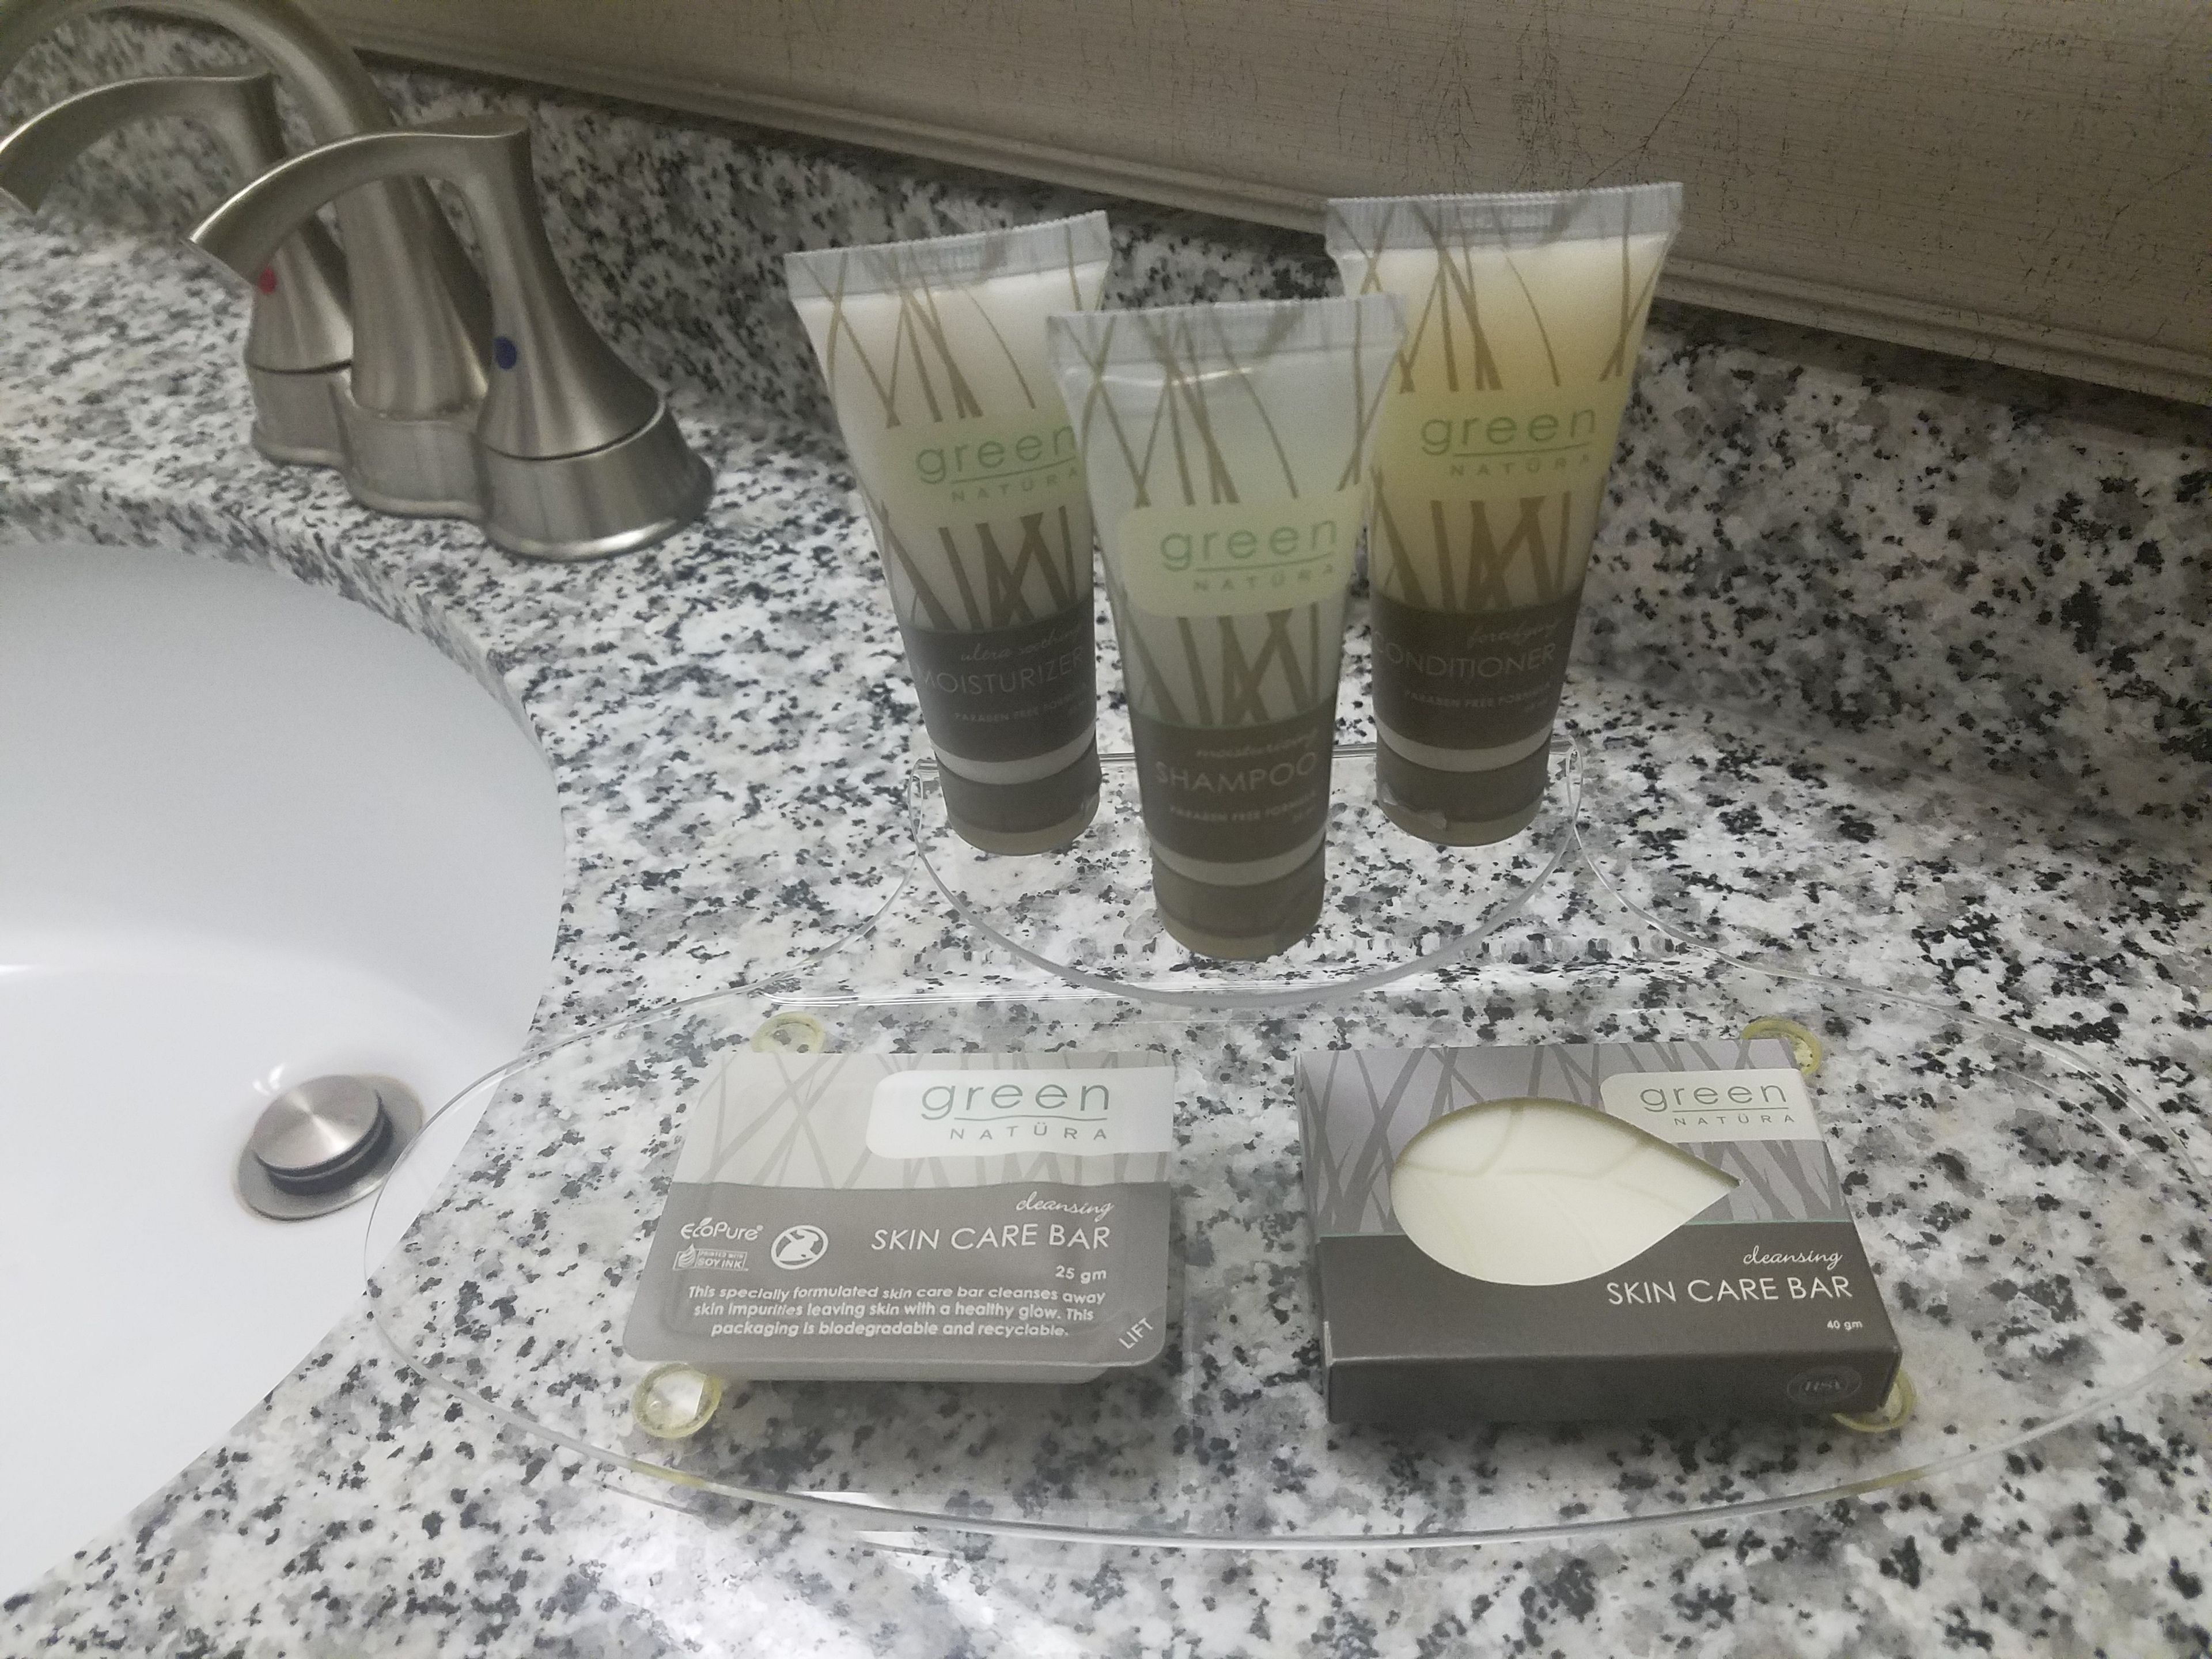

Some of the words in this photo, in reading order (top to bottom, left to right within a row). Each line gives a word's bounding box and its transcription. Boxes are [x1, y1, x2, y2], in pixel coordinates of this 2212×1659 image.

[1421, 408, 1596, 456] green
[915, 425, 1077, 484] green
[1160, 520, 1336, 572] green
[1154, 751, 1317, 793] SHAMPOO
[921, 1083, 1111, 1122] green
[1639, 1084, 1787, 1113] green
[950, 1122, 1108, 1141] NATÜRA
[1673, 1114, 1796, 1126] NATÜRA
[1016, 1191, 1115, 1222] cleansing
[871, 1228, 938, 1251] SKIN
[950, 1224, 1037, 1251] CARE
[1048, 1224, 1111, 1249] BAR
[697, 1258, 721, 1267] SOY
[721, 1259, 743, 1268] INK
[1743, 1245, 1843, 1271] cleansing
[1055, 1264, 1075, 1280] 25
[1080, 1269, 1107, 1285] gm
[690, 1285, 716, 1298] This
[719, 1287, 789, 1302] specially
[793, 1285, 880, 1299] formulated
[882, 1287, 912, 1300] skin
[916, 1287, 953, 1298] care
[957, 1286, 985, 1298] bar
[987, 1286, 1059, 1300] cleanses
[1062, 1291, 1106, 1305] away
[1606, 1280, 1676, 1305] SKIN
[1687, 1277, 1779, 1304] CARE
[1786, 1275, 1853, 1300] BAR
[694, 1302, 725, 1316] skin
[728, 1302, 804, 1318] impurities
[806, 1302, 865, 1319] leaving
[869, 1302, 900, 1316] skin
[904, 1301, 935, 1316] with
[939, 1305, 951, 1316] a
[955, 1301, 1014, 1320] healthy
[1018, 1305, 1061, 1321] glow.
[1066, 1308, 1094, 1321] This
[711, 1321, 800, 1337] packaging
[802, 1321, 815, 1335] is
[818, 1321, 938, 1337] biodegradable
[942, 1320, 975, 1335] and
[977, 1322, 1069, 1338] recyclable.
[1118, 1317, 1153, 1350] LIFT
[1826, 1320, 1841, 1330] 40
[1844, 1321, 1863, 1331] gm
